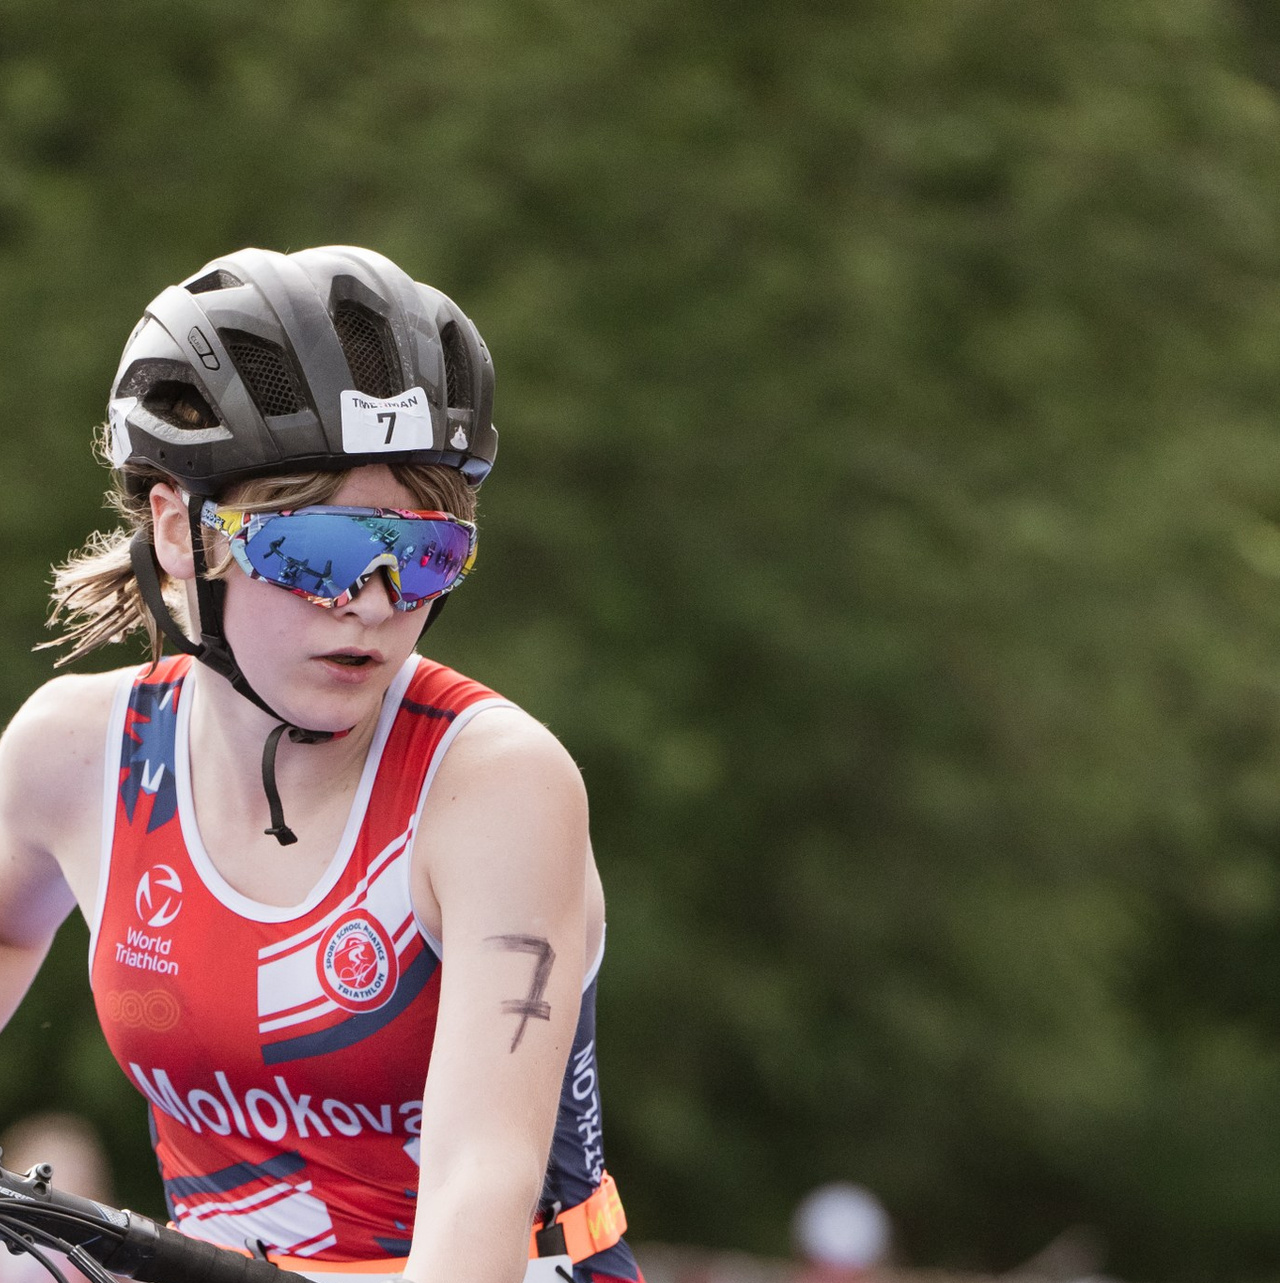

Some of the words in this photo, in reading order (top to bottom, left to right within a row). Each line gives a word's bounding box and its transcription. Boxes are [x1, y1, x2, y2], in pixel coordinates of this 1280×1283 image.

[376, 411, 397, 445] 7
[126, 925, 173, 955] World
[326, 940, 338, 970] SPORT
[363, 925, 386, 961] AUATICS
[115, 942, 179, 976] Triathlon
[337, 972, 386, 999] TRIATHLON
[483, 933, 557, 1054] 7
